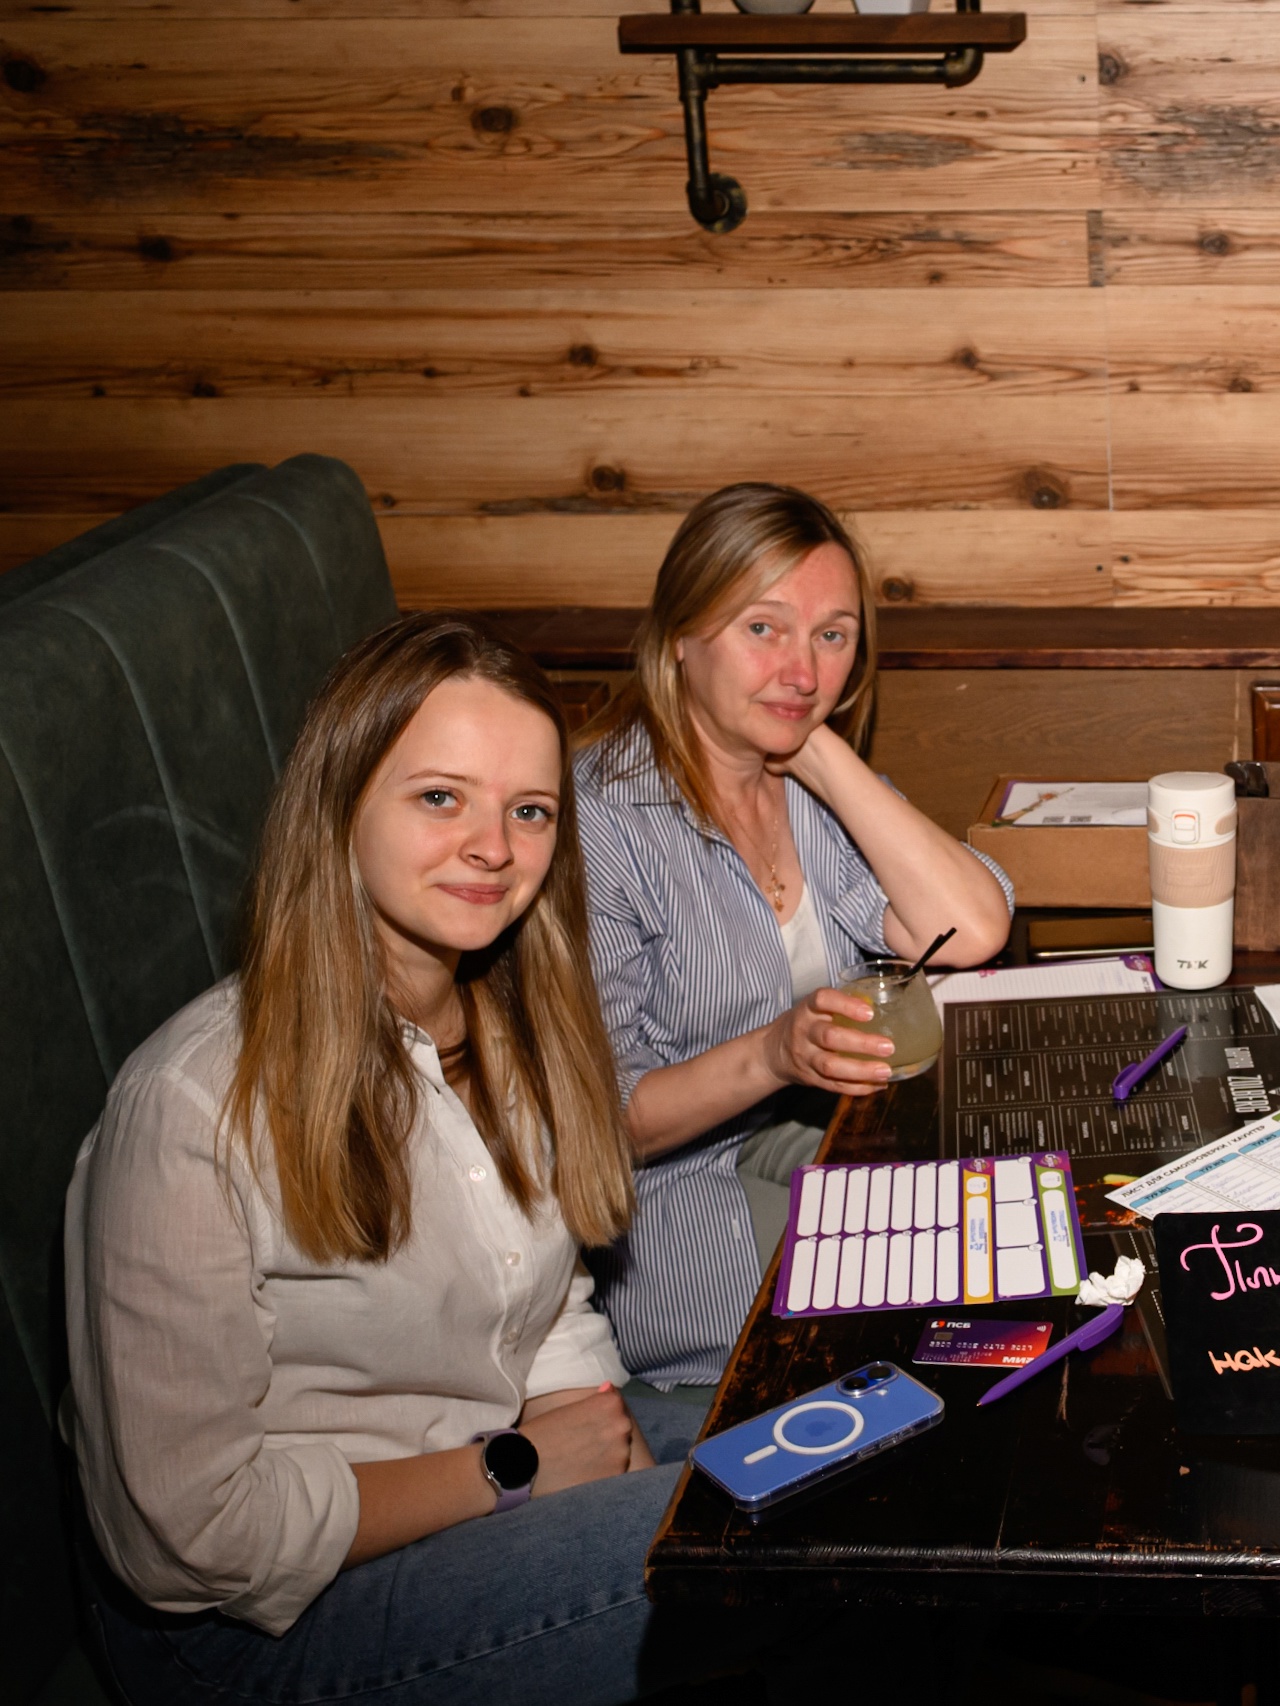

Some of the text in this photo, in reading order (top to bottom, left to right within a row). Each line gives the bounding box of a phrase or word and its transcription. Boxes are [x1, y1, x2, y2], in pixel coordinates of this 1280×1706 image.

[1227, 1074, 1271, 1113] ZOLBERG
[1121, 1183, 1145, 1198] ЛИСТ
[1146, 1175, 1163, 1188] ДЛЯ
[946, 1321, 971, 1329] ПСБ
